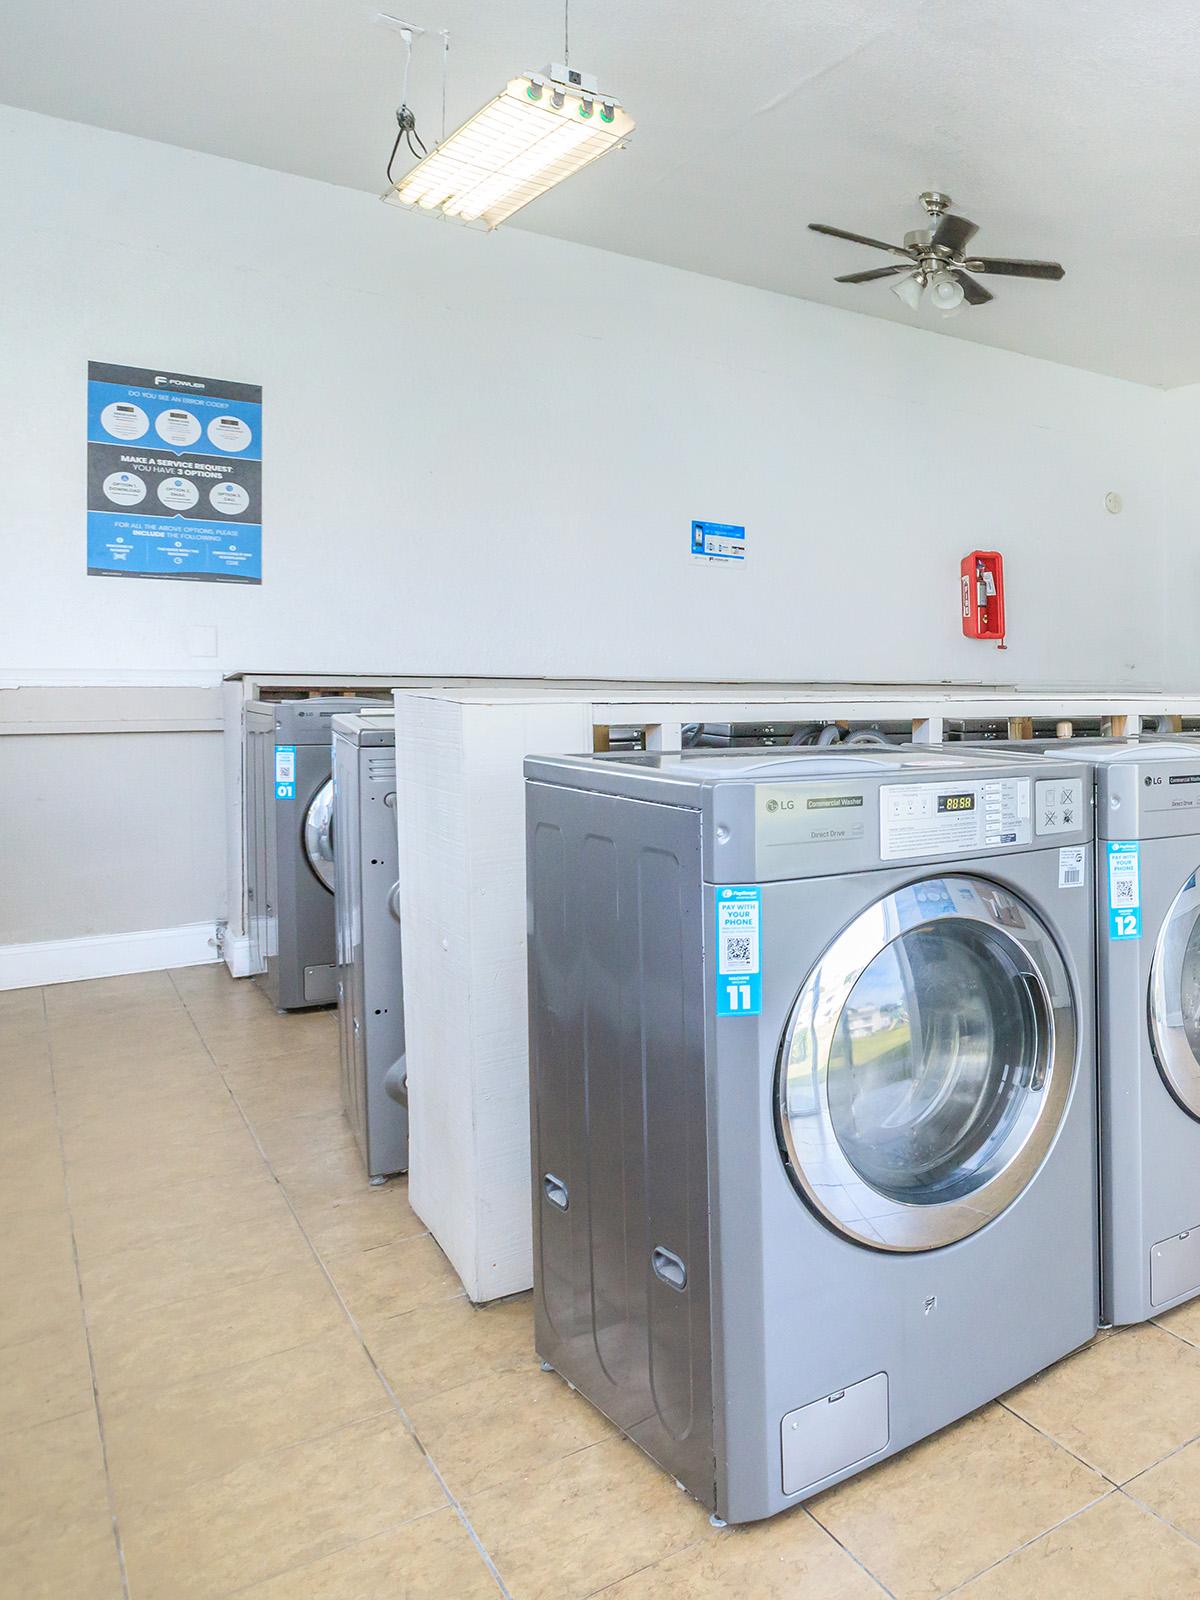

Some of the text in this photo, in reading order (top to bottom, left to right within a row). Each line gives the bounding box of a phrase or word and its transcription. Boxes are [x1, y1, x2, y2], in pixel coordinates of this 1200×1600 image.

[169, 379, 205, 388] FOWLER
[128, 390, 140, 398] DO
[142, 391, 157, 400] YOU
[120, 455, 148, 464] MAKE
[148, 458, 156, 466] A
[156, 459, 193, 469] SERVICE
[132, 464, 153, 473] YOU
[153, 466, 176, 475] HAVE
[184, 470, 223, 479] OPTIONS
[132, 530, 166, 538] INCLUDE
[1153, 776, 1162, 785] LG
[277, 785, 293, 797] 01
[780, 798, 862, 810] LG Commercial Washer
[725, 918, 753, 926] PHONE
[1114, 915, 1137, 936] 12
[726, 985, 751, 1010] 11
